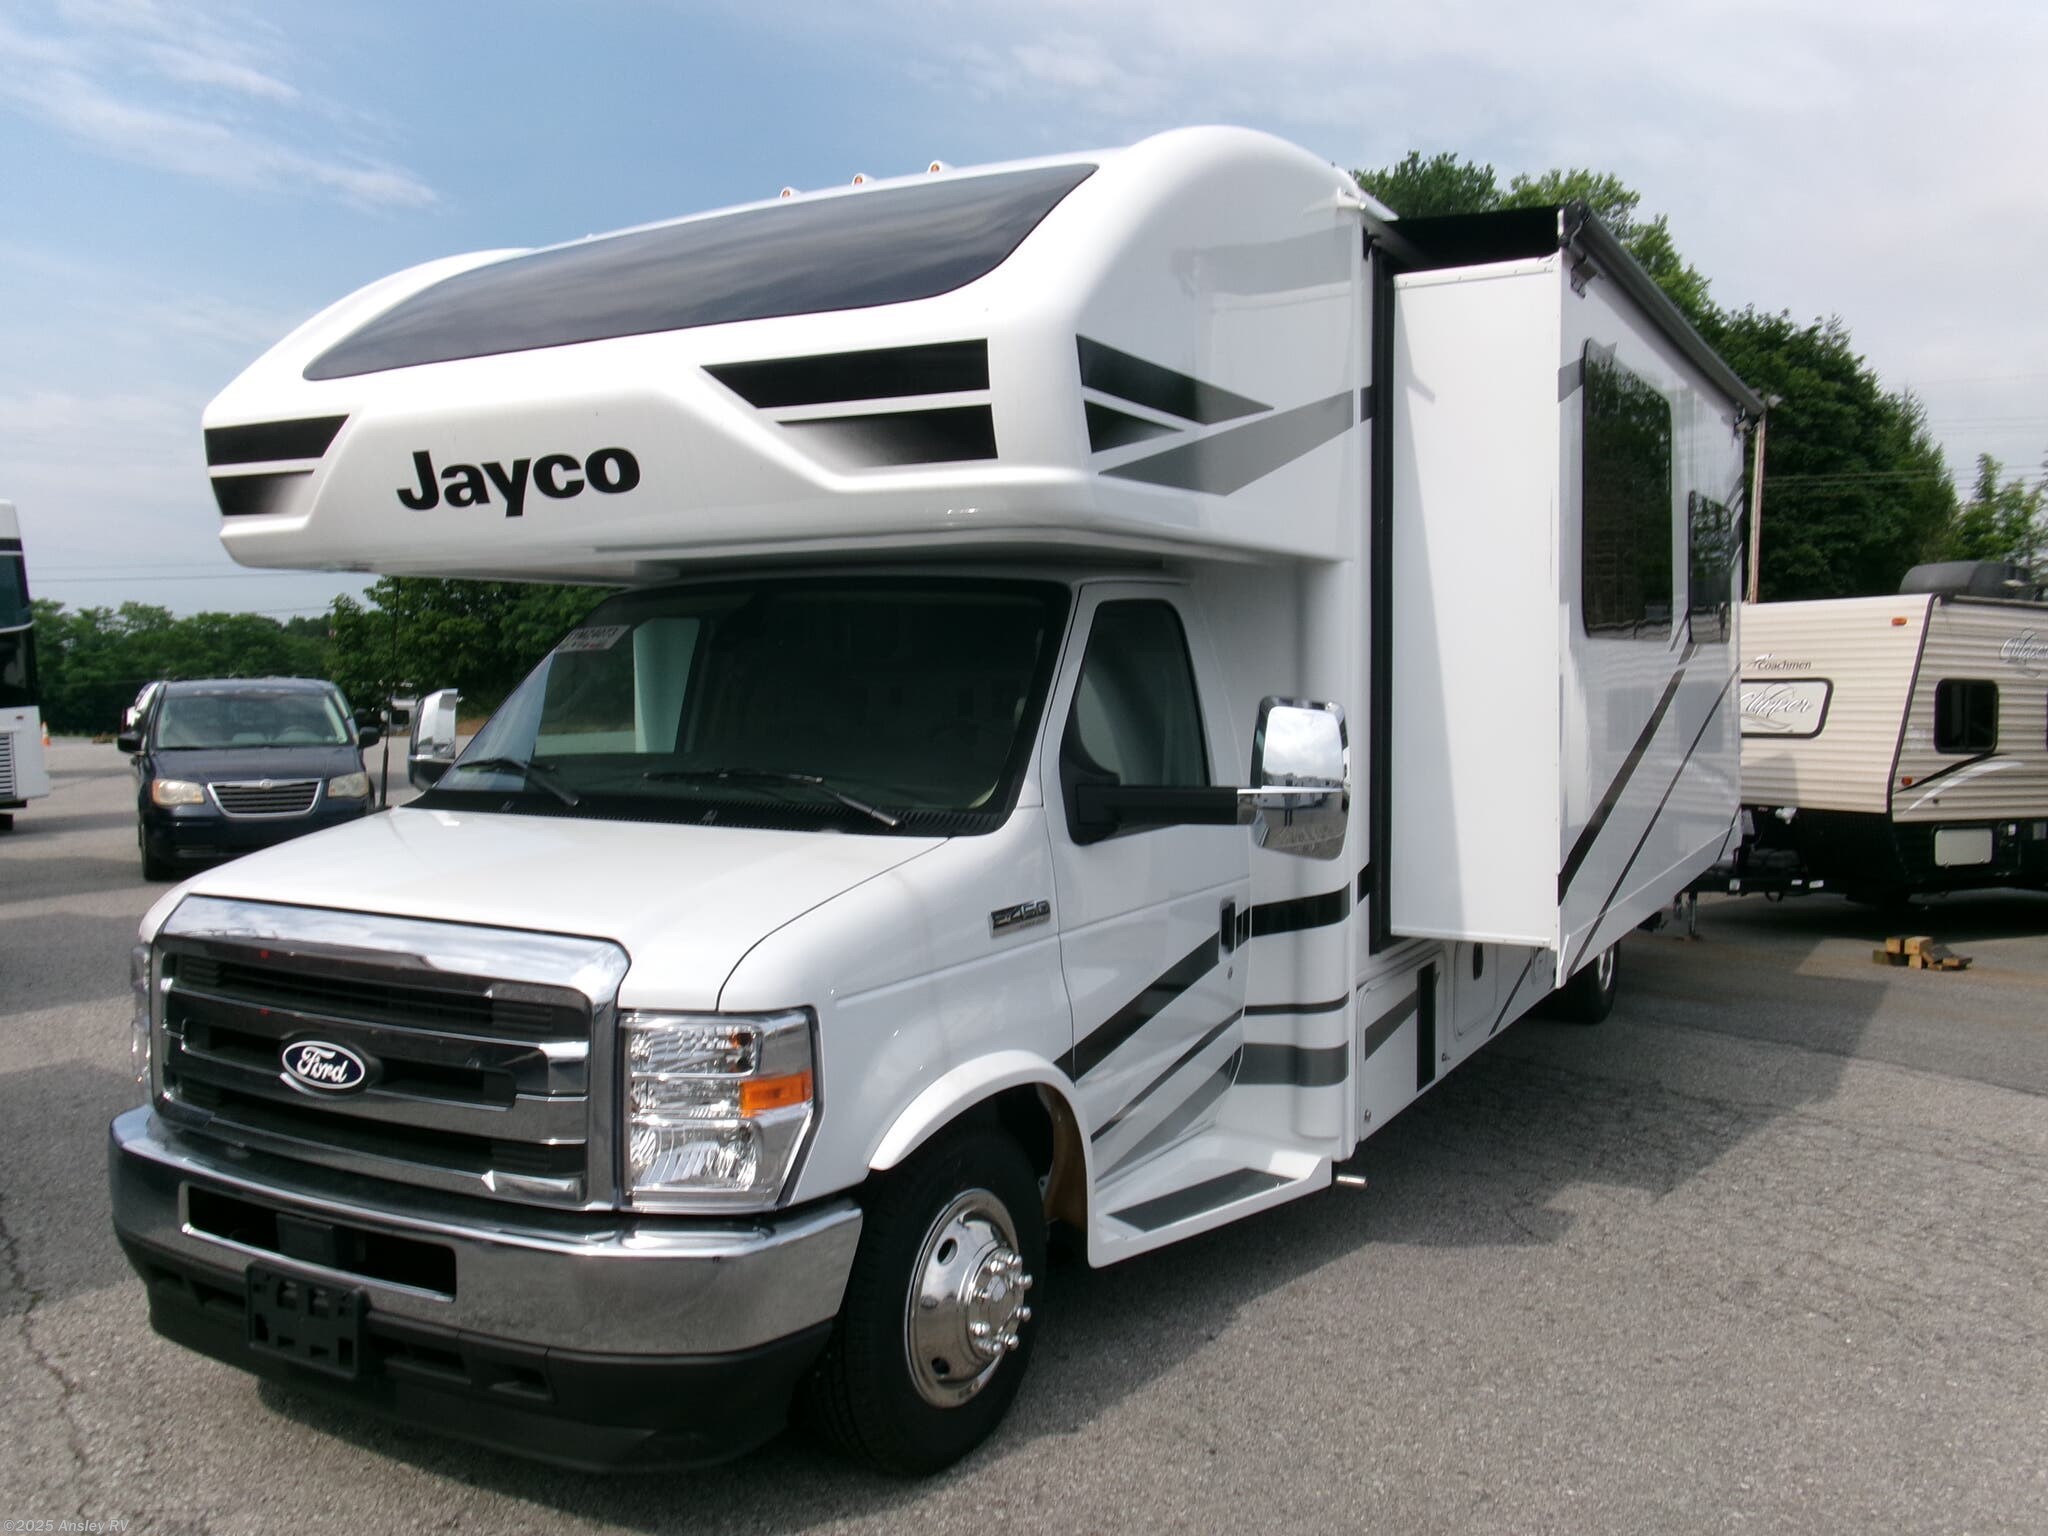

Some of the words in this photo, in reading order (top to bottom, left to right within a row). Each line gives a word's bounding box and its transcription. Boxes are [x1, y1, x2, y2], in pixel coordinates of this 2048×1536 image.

[396, 447, 641, 518] Jayco
[1756, 659, 1812, 671] Coachmen
[297, 1046, 348, 1083] Ford
